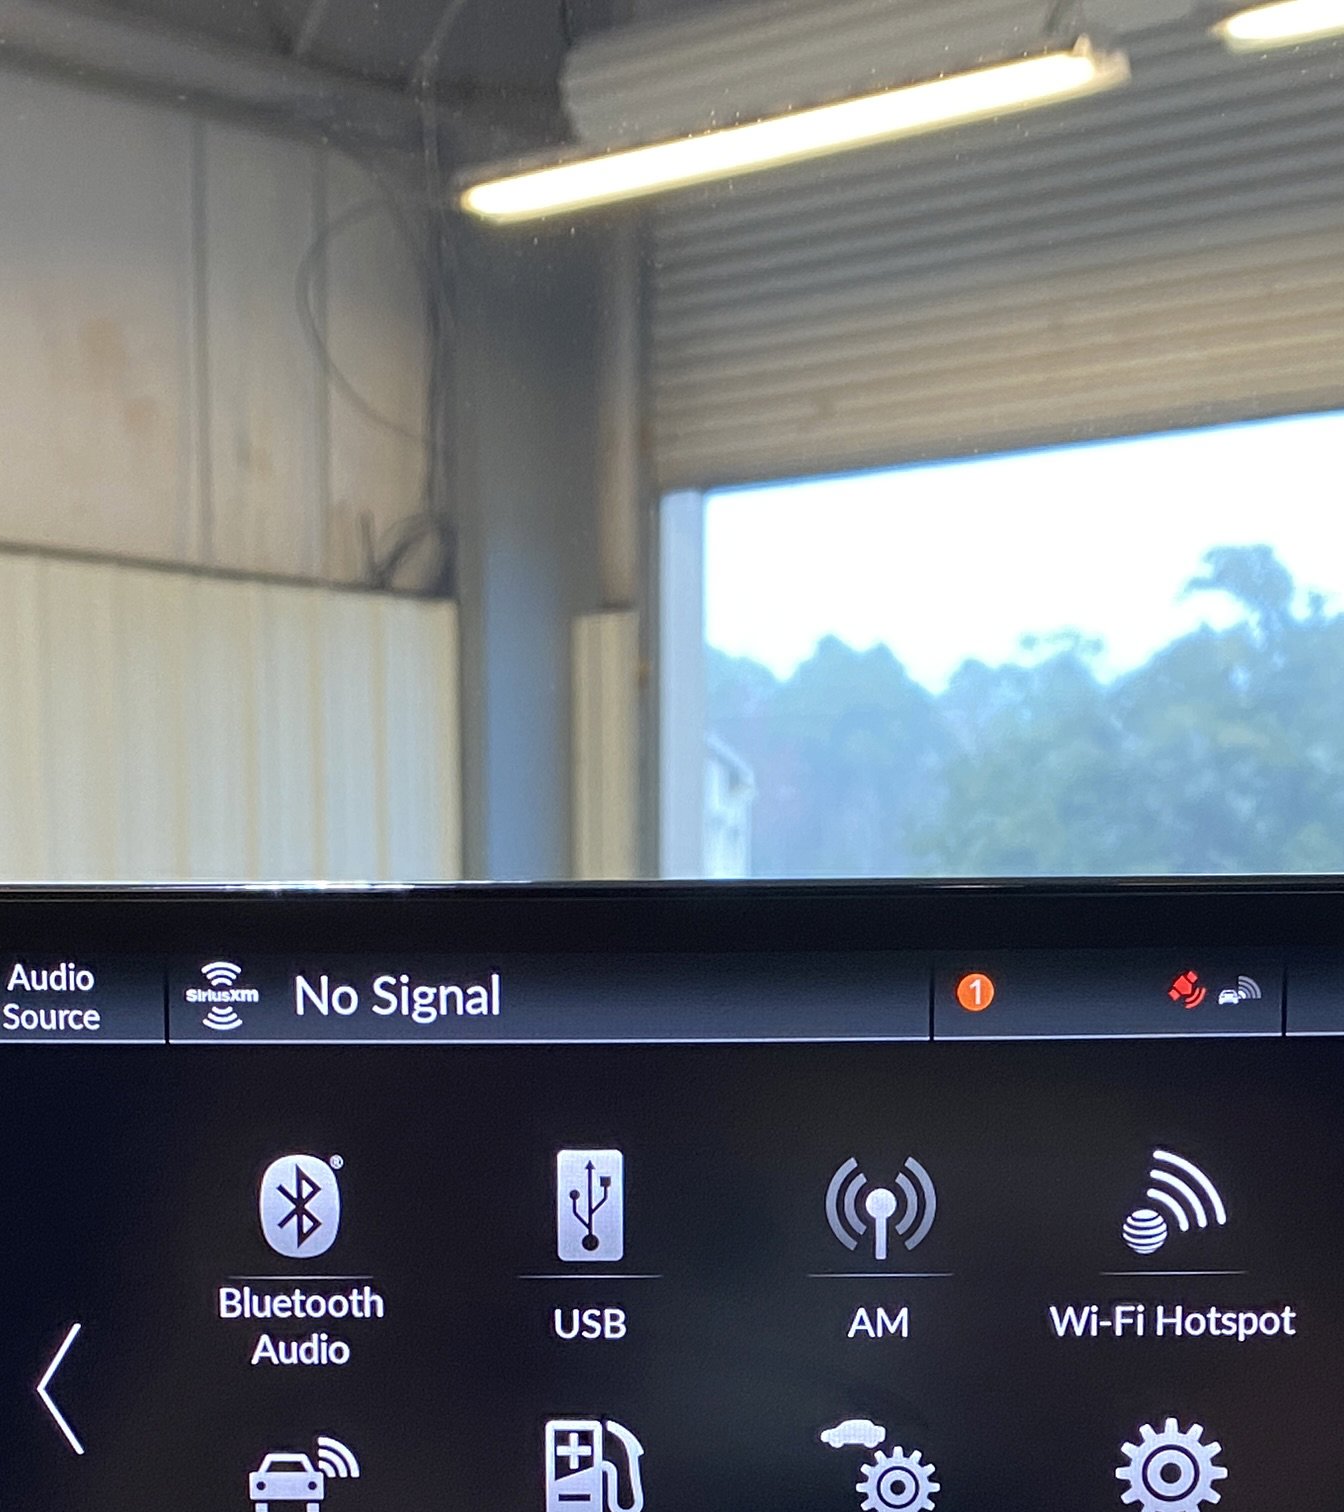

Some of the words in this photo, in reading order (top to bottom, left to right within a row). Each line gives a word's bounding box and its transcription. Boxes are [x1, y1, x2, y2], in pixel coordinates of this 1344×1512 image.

[6, 962, 95, 992] Audio
[295, 975, 359, 1016] No
[371, 973, 500, 1025] Signal
[2, 1002, 101, 1031] Source
[219, 1285, 384, 1318] Bluetooth
[554, 1308, 627, 1339] USB
[847, 1307, 909, 1338] AM
[1049, 1304, 1145, 1337] Wi-Fi
[1156, 1305, 1297, 1342] Hotspot
[251, 1332, 350, 1365] Audio
